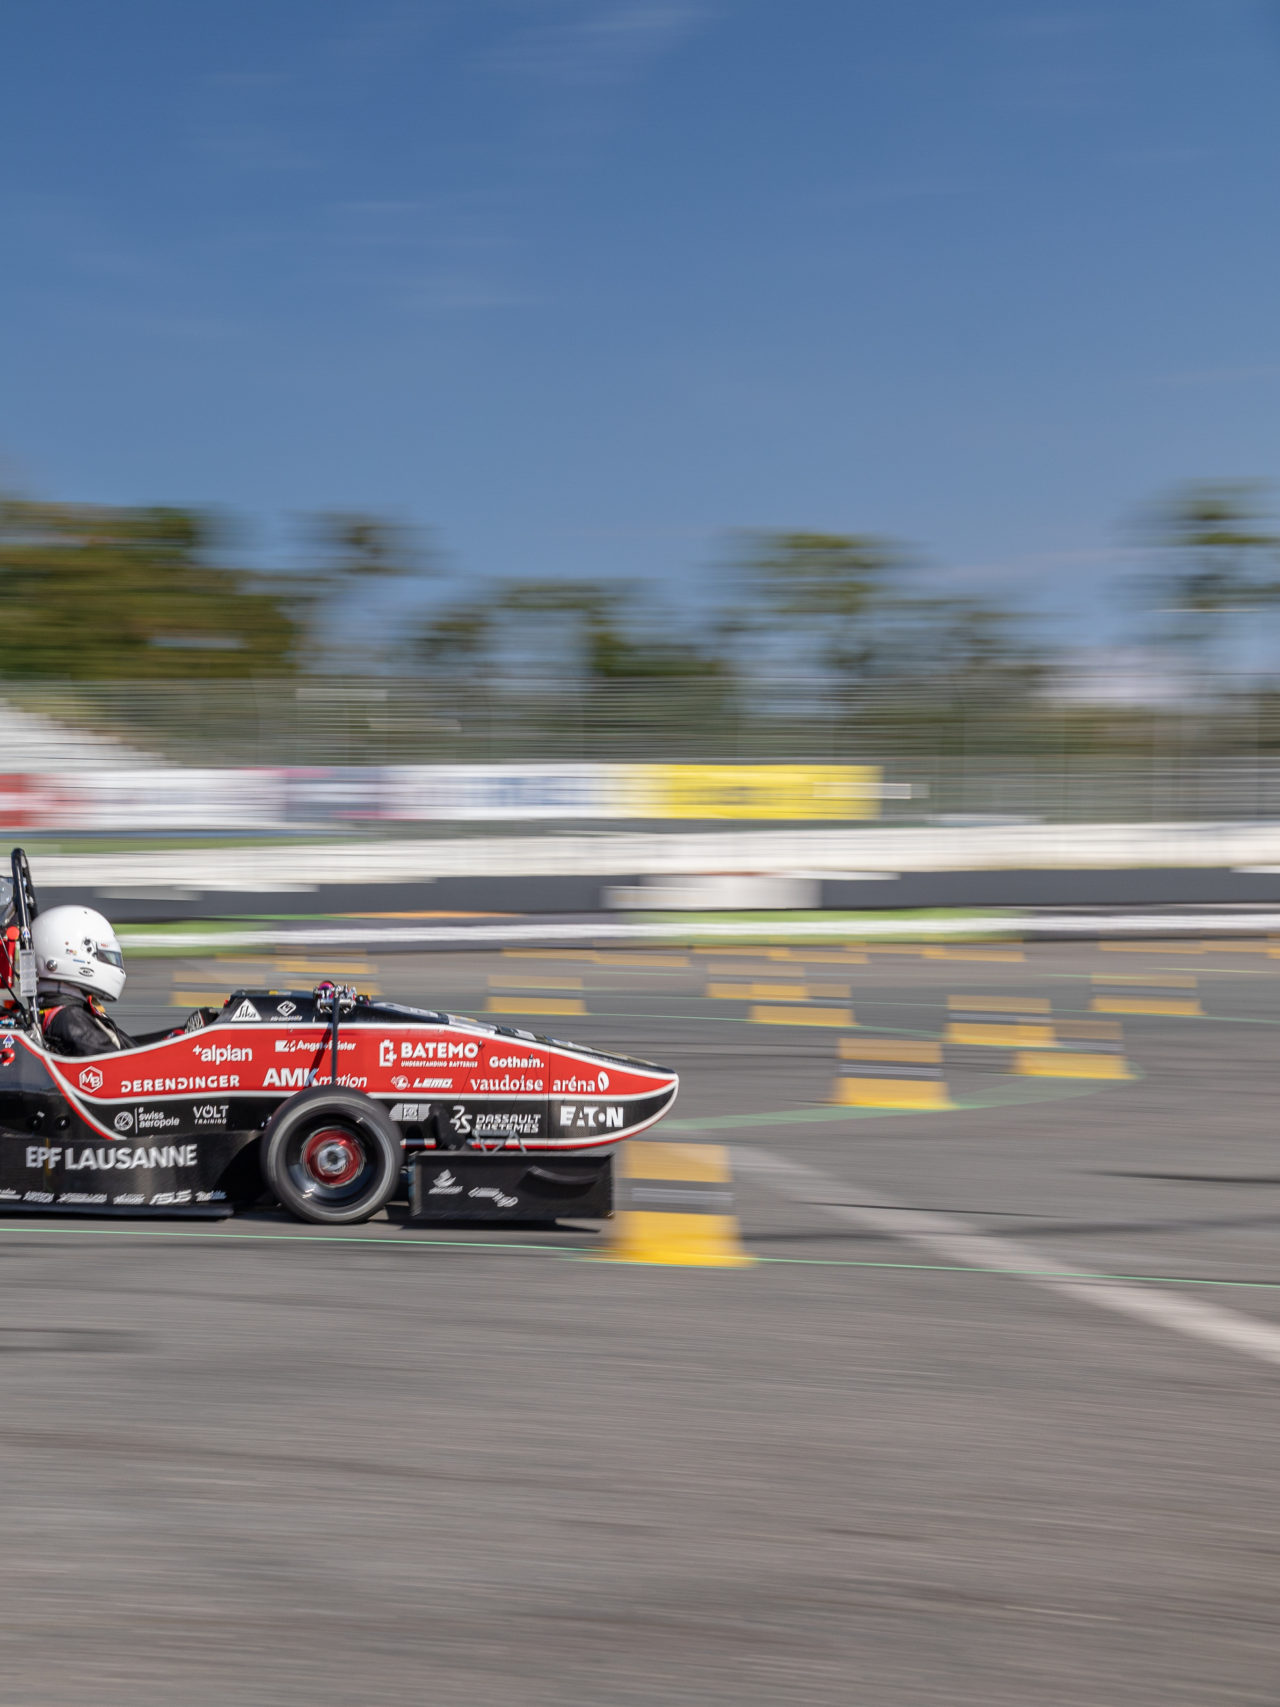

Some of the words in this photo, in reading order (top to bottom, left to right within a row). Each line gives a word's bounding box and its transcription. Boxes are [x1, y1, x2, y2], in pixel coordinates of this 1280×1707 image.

[401, 1042, 479, 1059] BATEMO
[401, 1060, 447, 1068] UNDERSTANDING
[448, 1060, 478, 1068] BATTERIES
[121, 1075, 240, 1093] DERENDINGER
[470, 1074, 544, 1091] vaudoise
[552, 1075, 596, 1092] aréna
[138, 1110, 164, 1121] swiss
[192, 1104, 229, 1118] VOLT
[560, 1105, 624, 1128] EATON
[139, 1116, 180, 1128] aeropole
[194, 1117, 227, 1125] TRAINING
[476, 1113, 541, 1124] DASSAULT
[26, 1146, 62, 1169] EPF
[65, 1144, 198, 1170] LAUSANNE
